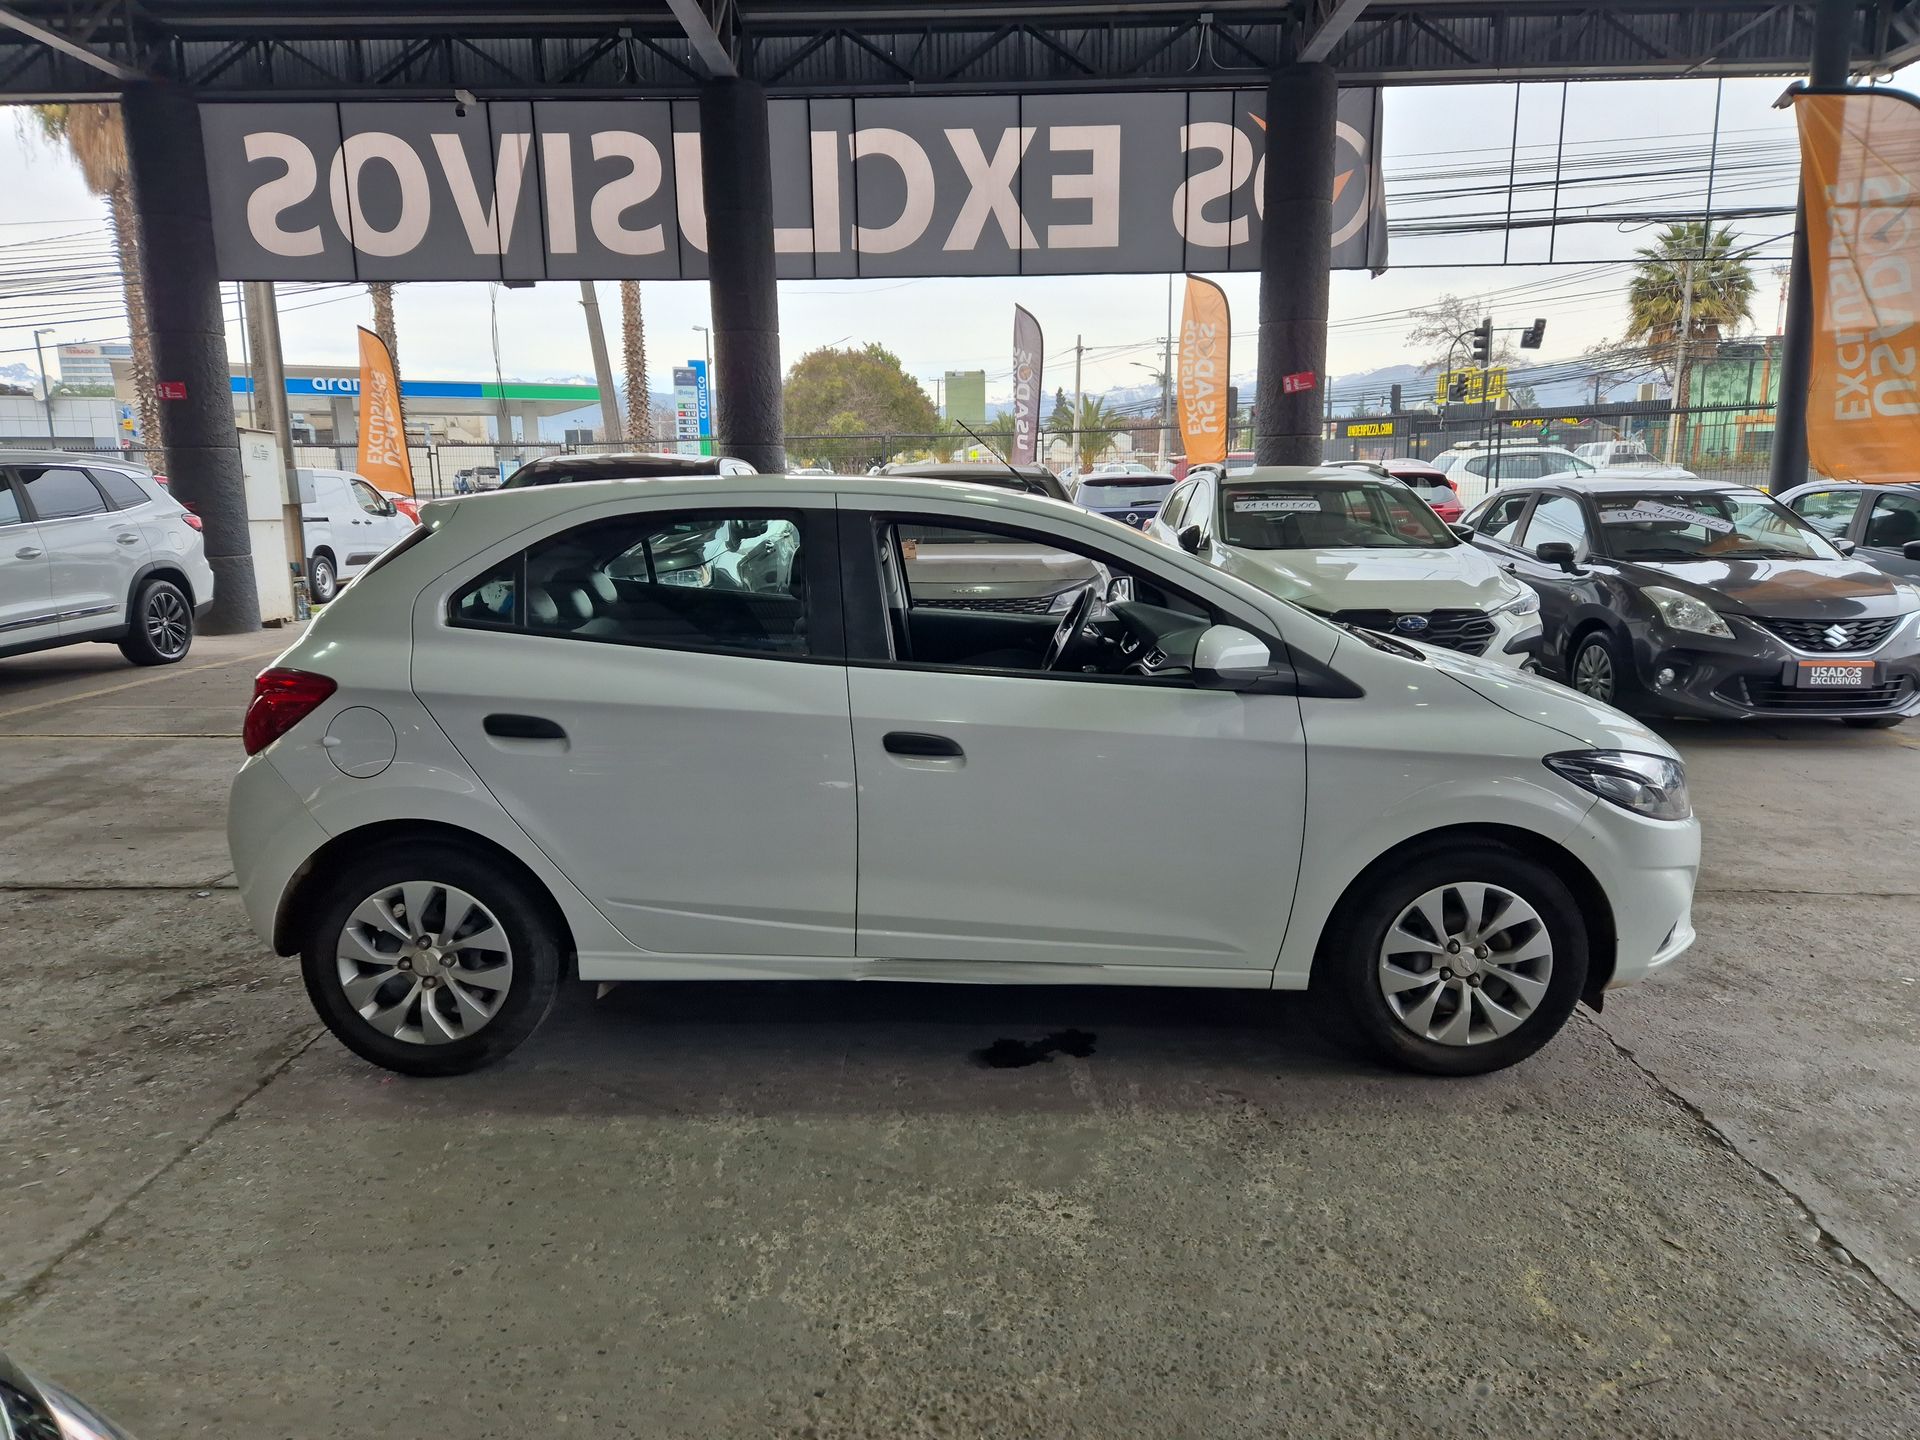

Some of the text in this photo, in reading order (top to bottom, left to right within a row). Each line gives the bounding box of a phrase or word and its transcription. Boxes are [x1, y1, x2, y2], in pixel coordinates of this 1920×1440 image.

[697, 376, 707, 419] aramco
[1347, 422, 1393, 437] UNDERPIZZA.COM
[1811, 667, 1862, 677] USADOS
[1810, 677, 1862, 685] EXCLUSIVOS
